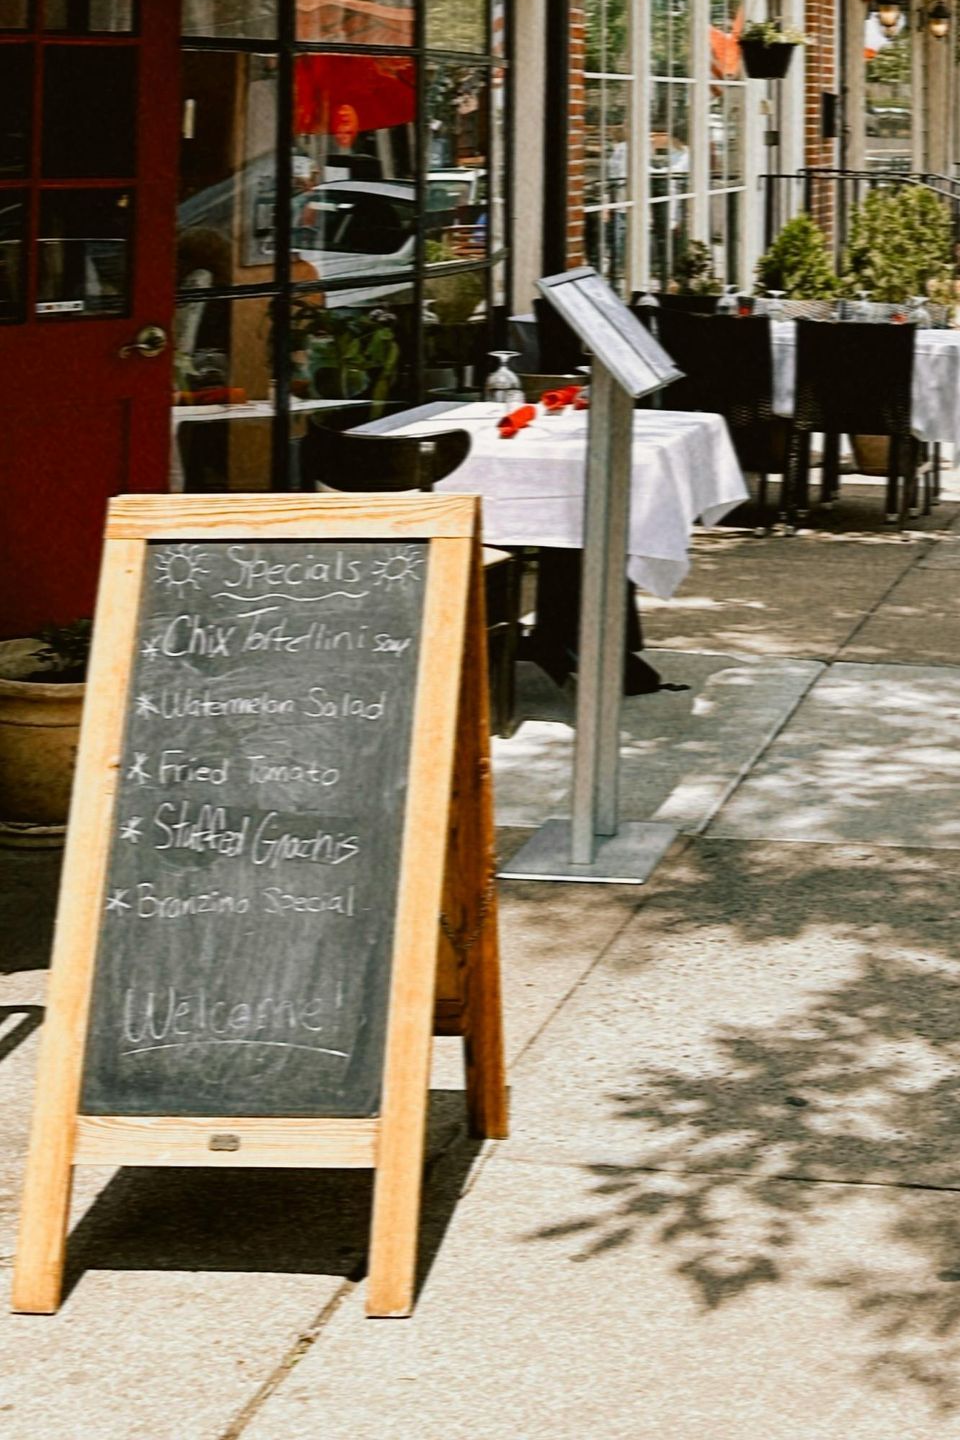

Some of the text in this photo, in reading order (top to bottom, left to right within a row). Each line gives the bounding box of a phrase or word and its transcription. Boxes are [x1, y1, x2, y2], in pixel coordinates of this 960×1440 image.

[224, 545, 362, 589] Specials
[161, 687, 387, 720] Watermelon Salad
[159, 749, 340, 787] Fried Tomato
[153, 800, 250, 857] Stuffed
[136, 882, 355, 919] Branzino Special
